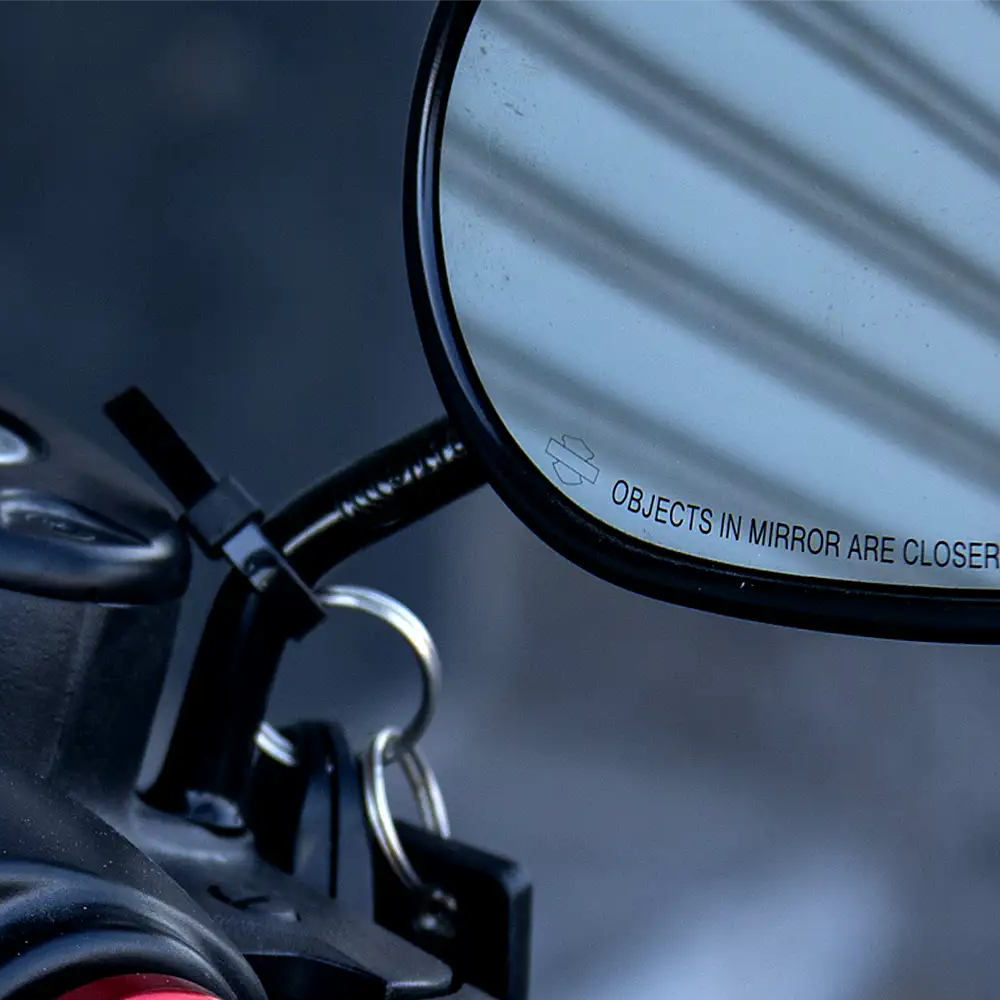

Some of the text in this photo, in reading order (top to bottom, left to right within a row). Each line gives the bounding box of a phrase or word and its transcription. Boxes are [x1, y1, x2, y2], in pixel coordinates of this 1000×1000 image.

[611, 479, 1000, 569] OBJECTS IN MIRROR ARE CLOSER
